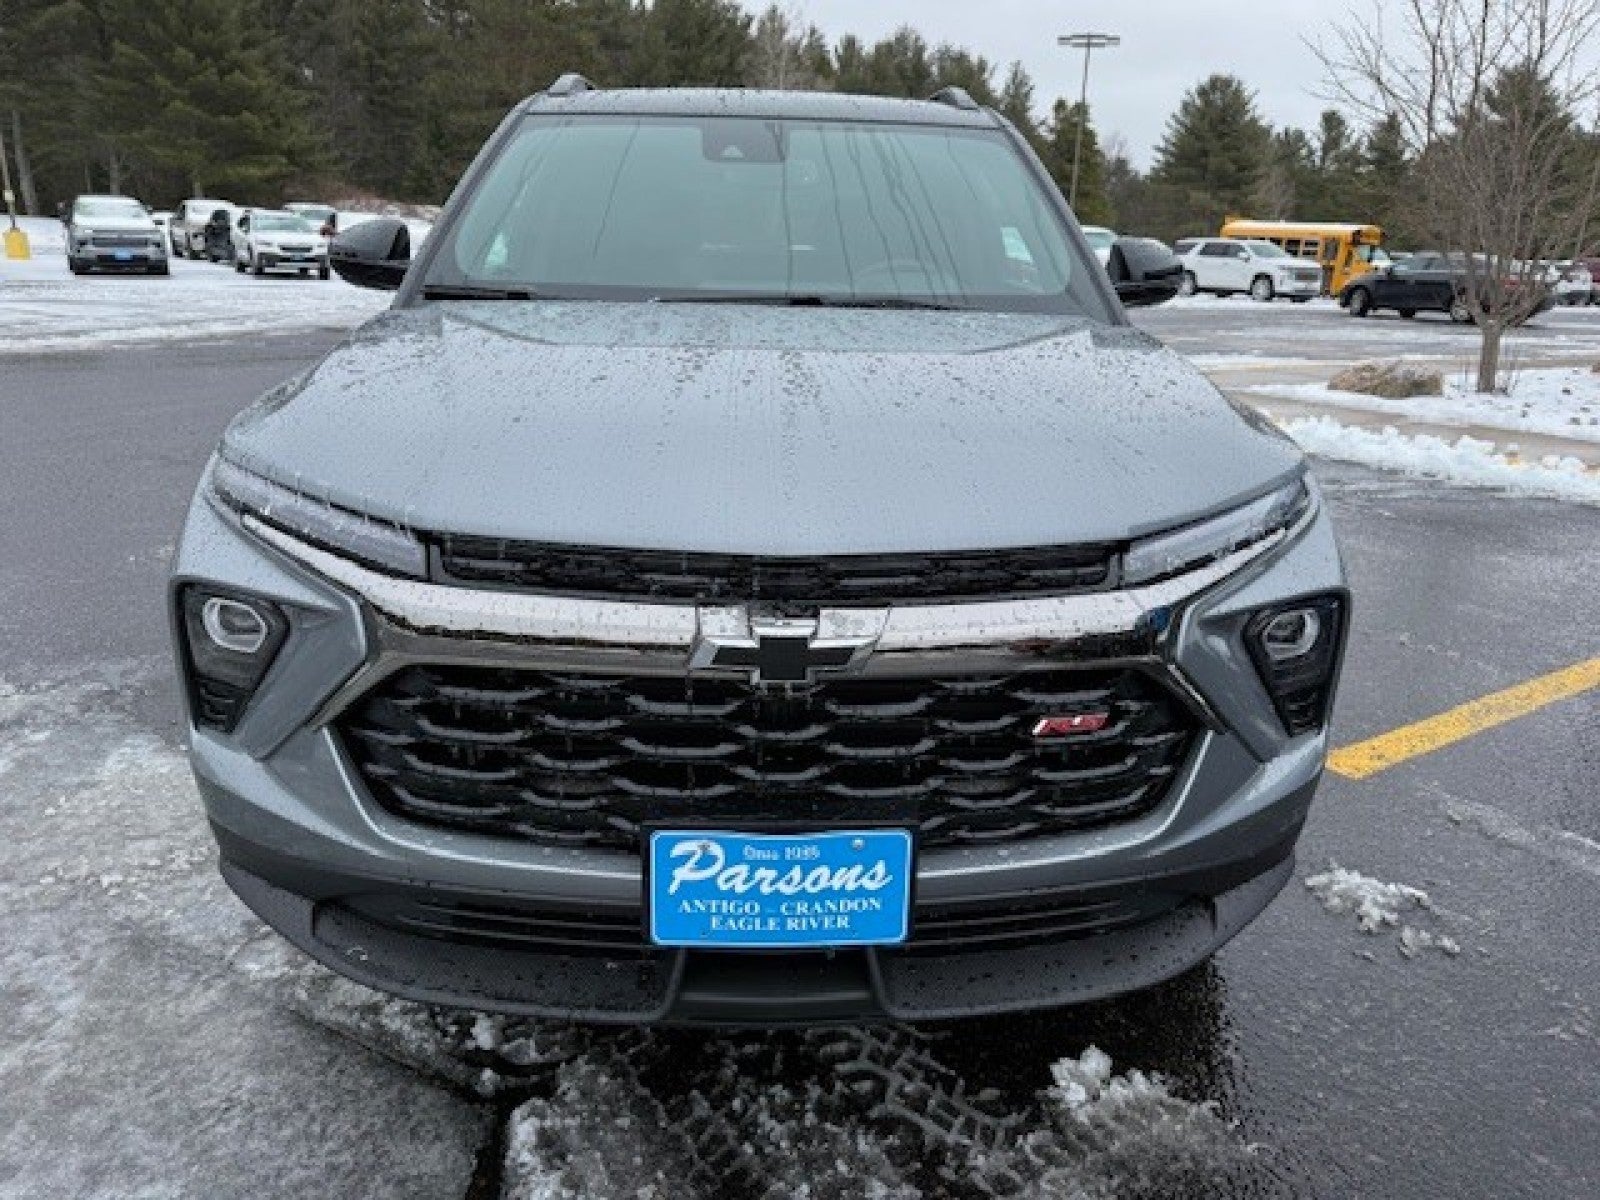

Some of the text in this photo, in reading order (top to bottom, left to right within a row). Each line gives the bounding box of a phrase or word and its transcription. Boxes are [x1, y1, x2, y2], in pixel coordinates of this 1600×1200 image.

[668, 840, 893, 895] Parsons
[680, 900, 760, 915] ANTIGO
[780, 898, 881, 915] CRANDON
[711, 916, 850, 931] EAGLE RIVER
